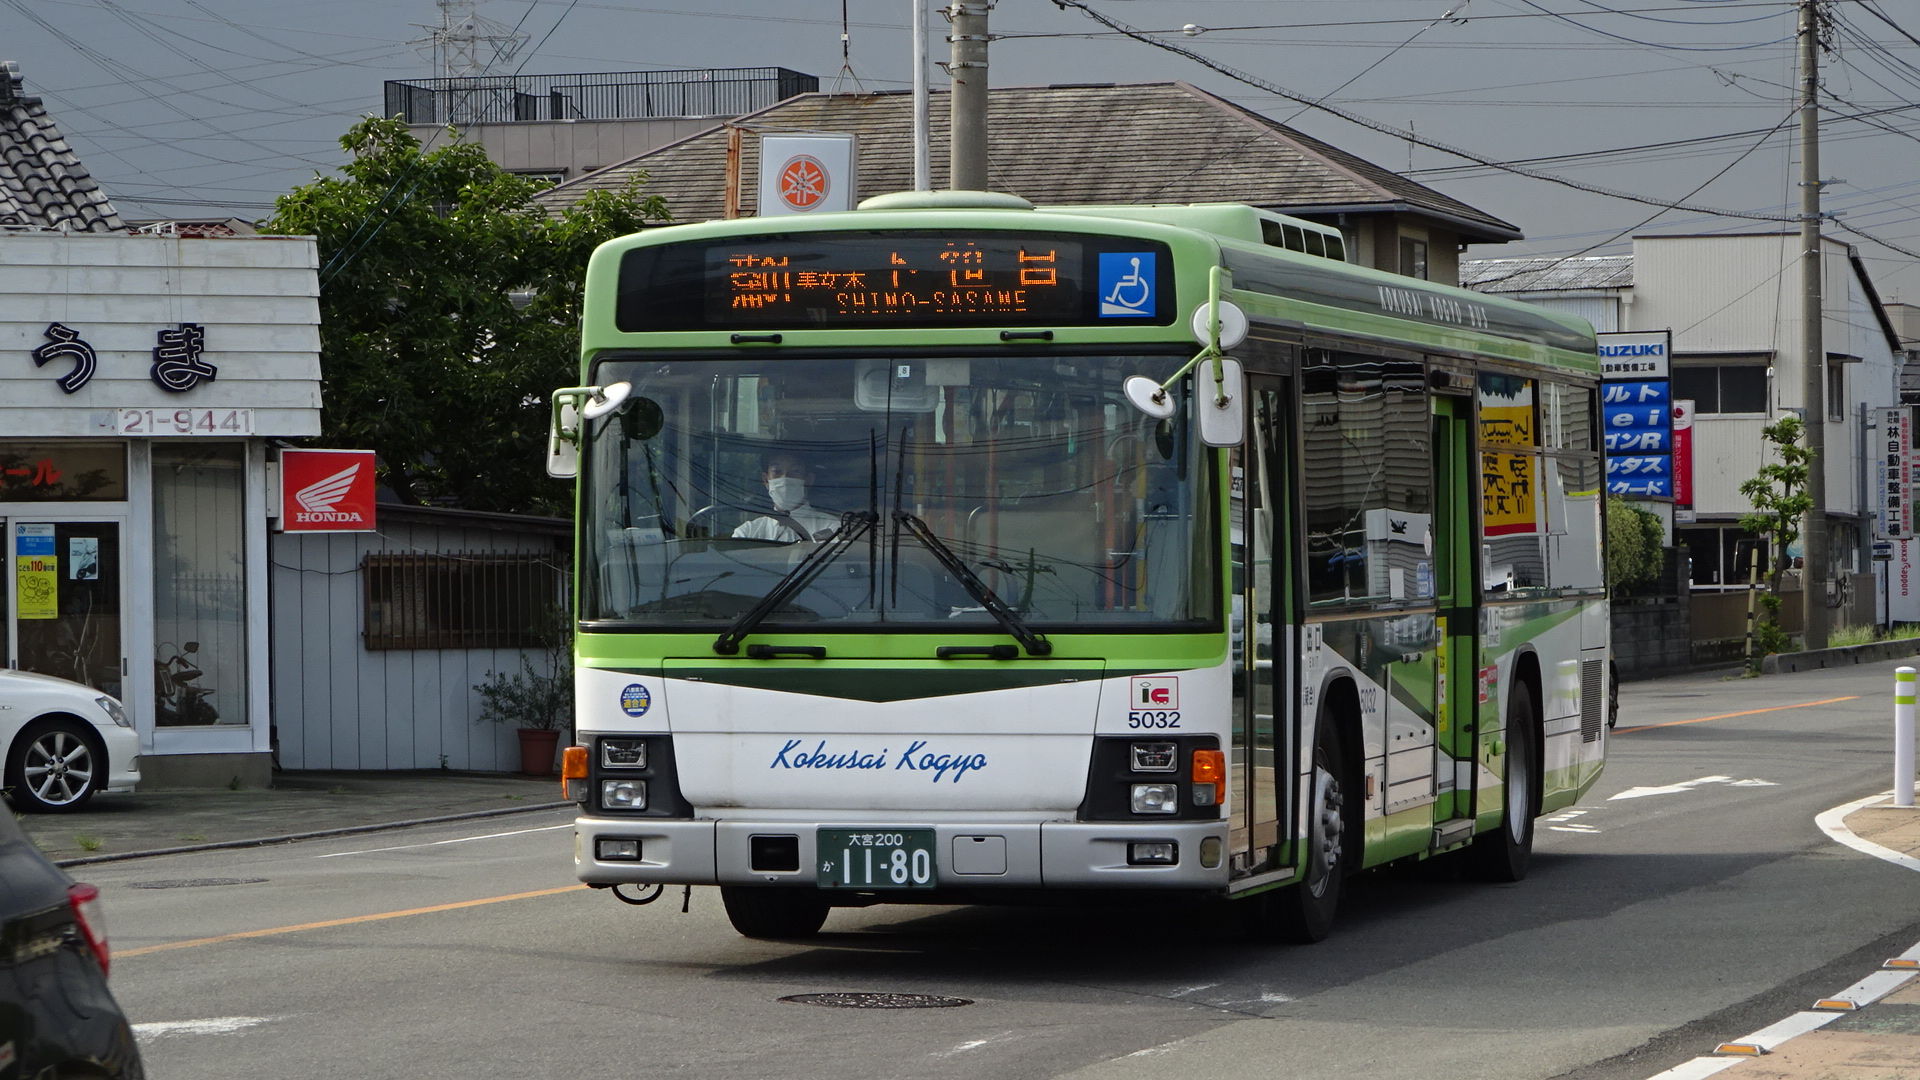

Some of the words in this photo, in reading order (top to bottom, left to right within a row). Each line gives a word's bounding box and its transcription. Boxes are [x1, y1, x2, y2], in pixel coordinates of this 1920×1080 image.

[797, 271, 866, 290] 美女木
[1378, 285, 1423, 317] KOKUSAI
[1428, 295, 1462, 324] KOGYO
[1468, 303, 1488, 329] BUS
[1599, 343, 1664, 357] SUZUKI
[1607, 480, 1664, 496] クード
[1887, 426, 1900, 536] 林自動車整備工場
[296, 512, 363, 522] HONDA
[1128, 711, 1181, 728] 5032
[770, 739, 888, 769] Kokusai
[895, 740, 987, 783] Kogyo
[823, 861, 834, 872] か
[843, 848, 930, 884] 11-80
